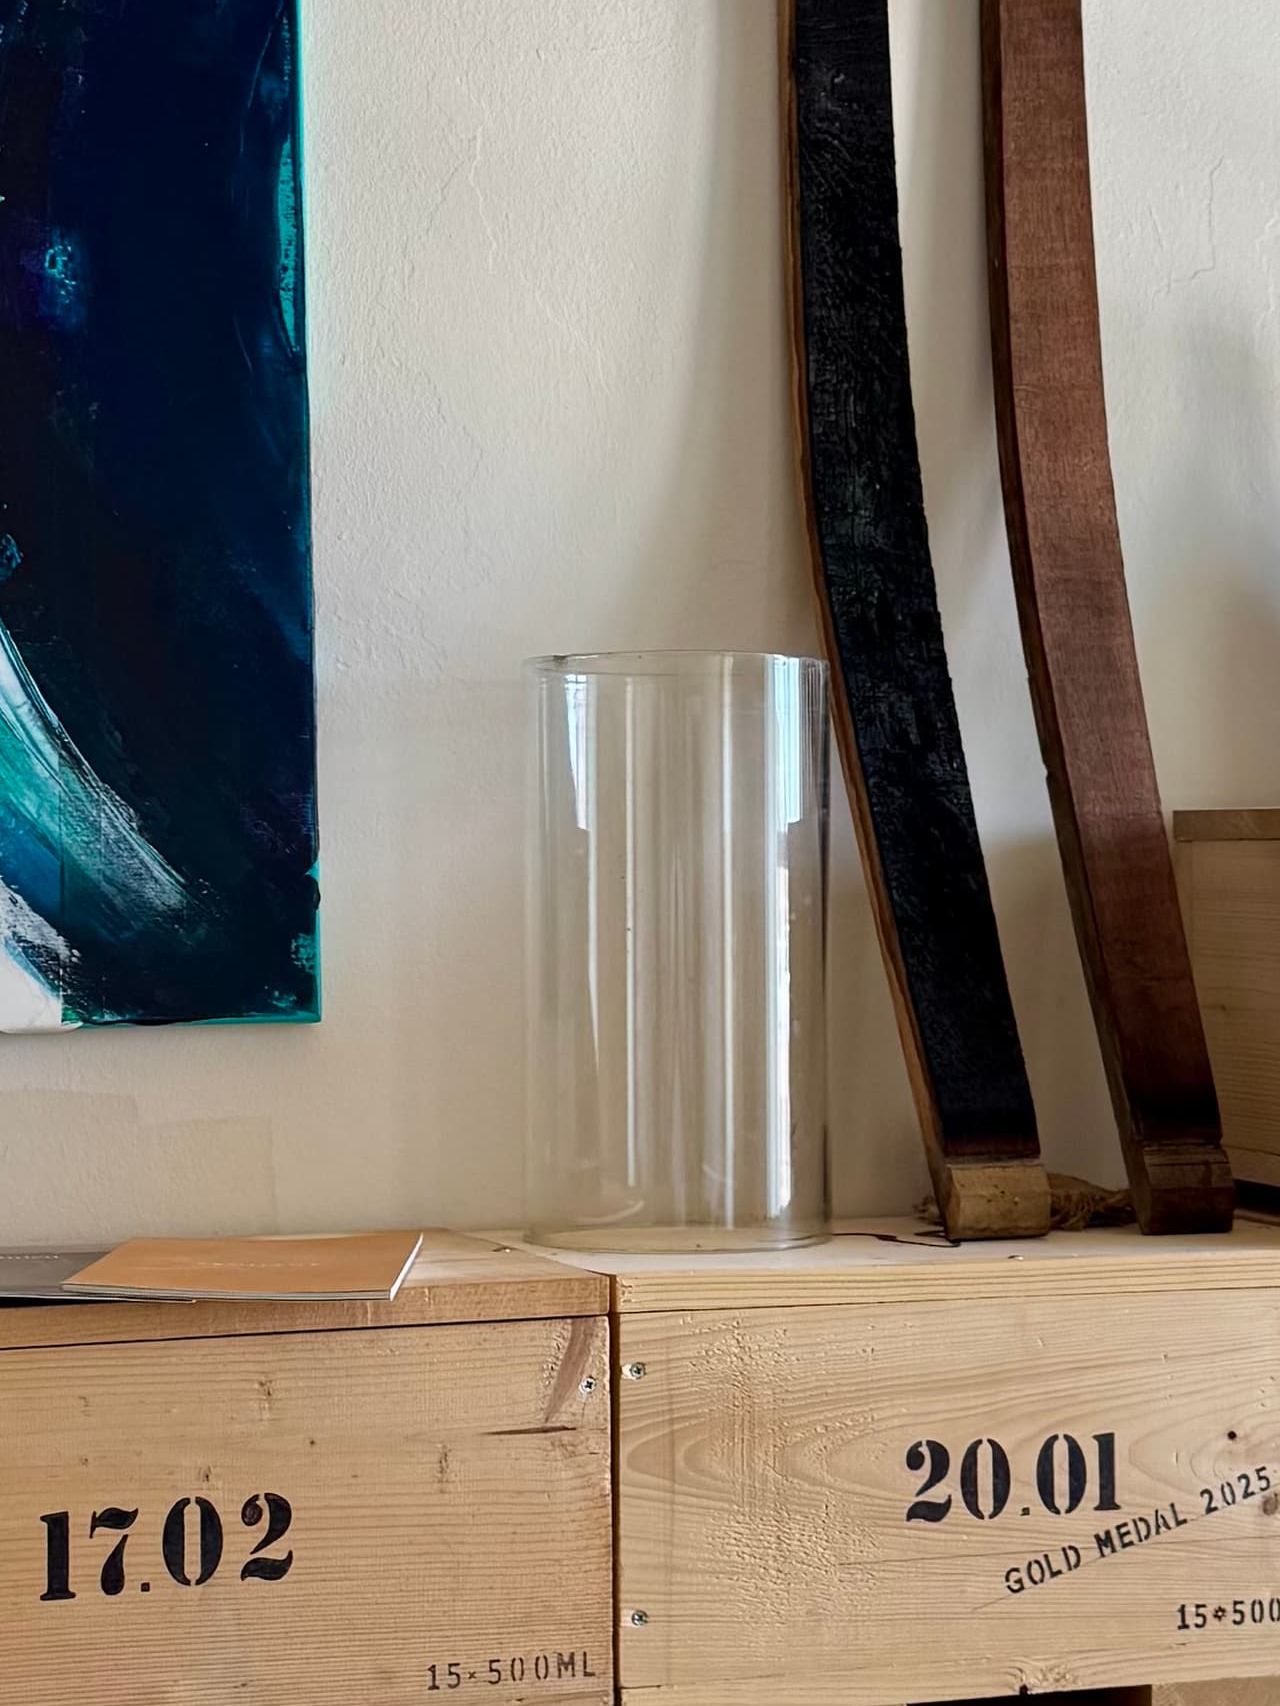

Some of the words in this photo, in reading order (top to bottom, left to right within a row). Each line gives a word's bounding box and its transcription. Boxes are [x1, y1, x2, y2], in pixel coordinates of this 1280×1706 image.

[906, 1432, 1121, 1523] 20.01
[1004, 1546, 1081, 1595] GOLD
[1098, 1508, 1189, 1559] MEDAL
[1200, 1466, 1273, 1517] 2025
[39, 1492, 294, 1602] 17.02
